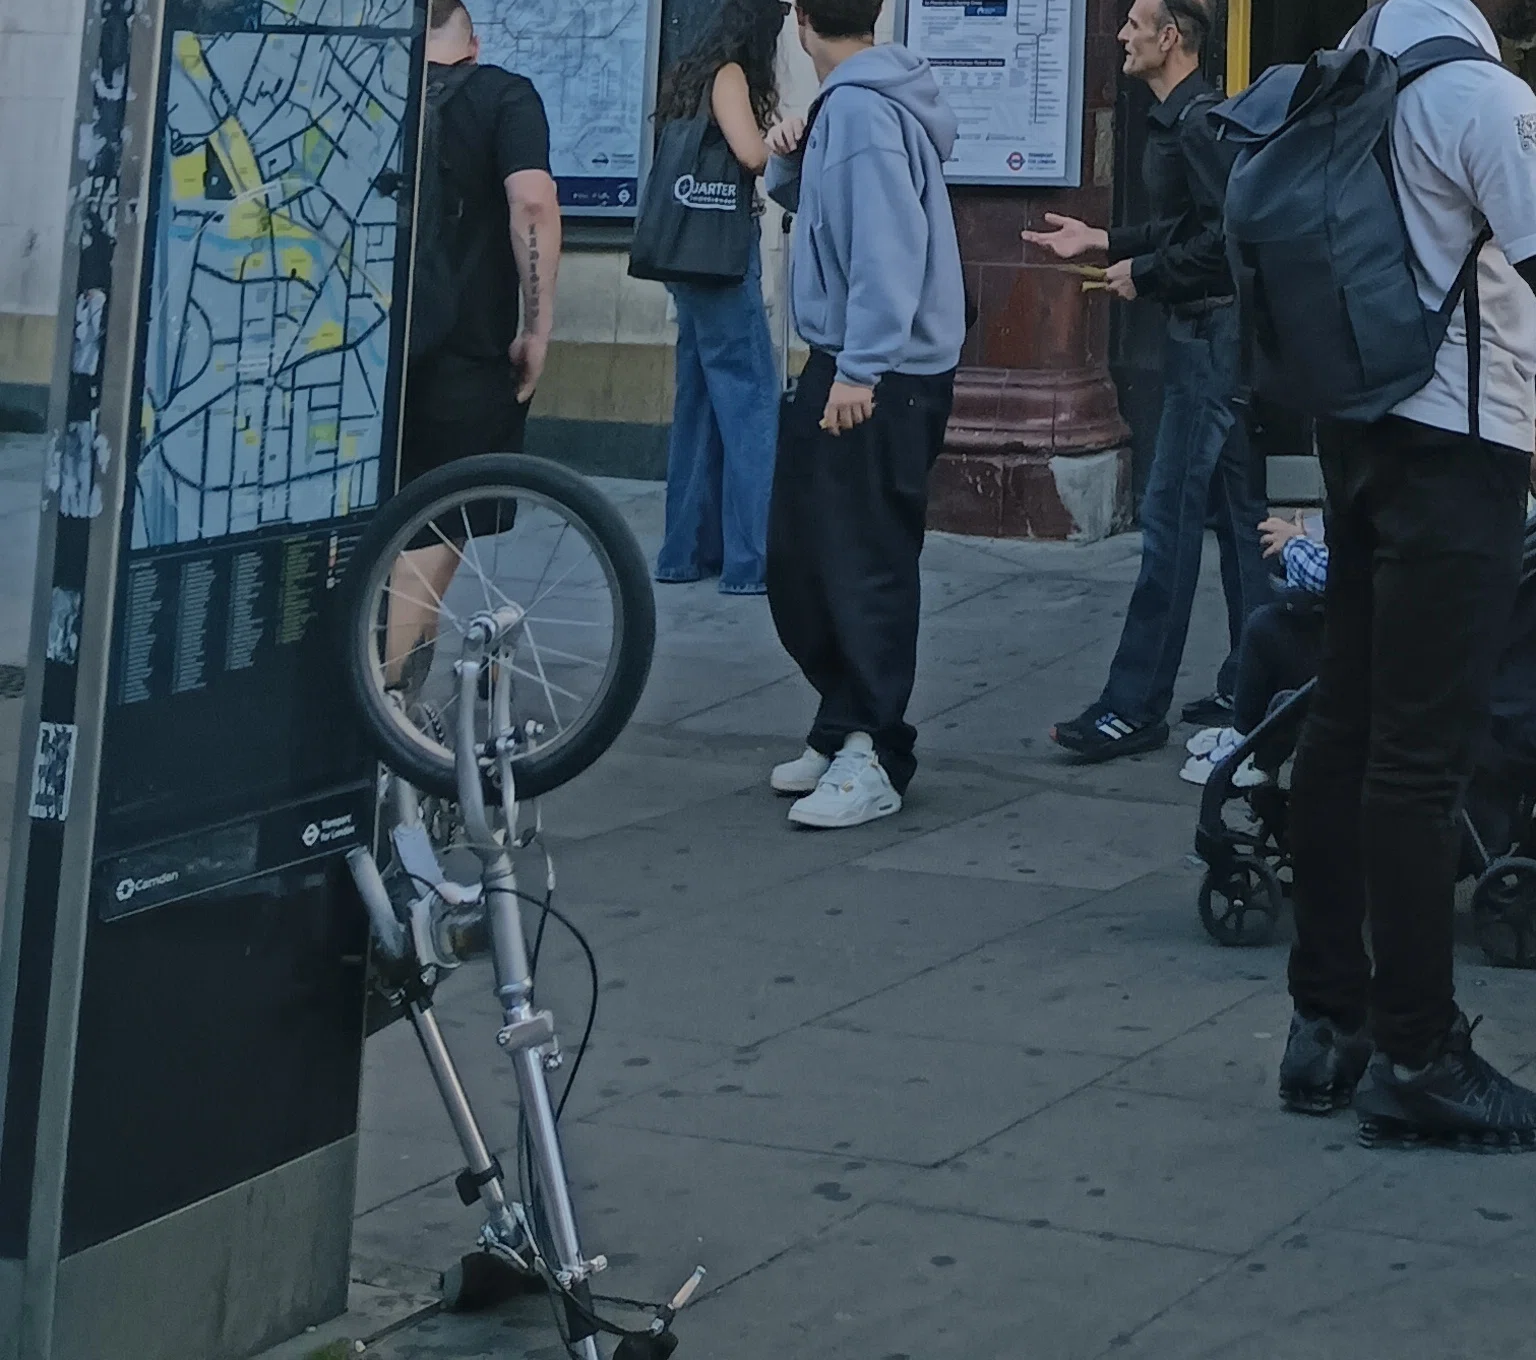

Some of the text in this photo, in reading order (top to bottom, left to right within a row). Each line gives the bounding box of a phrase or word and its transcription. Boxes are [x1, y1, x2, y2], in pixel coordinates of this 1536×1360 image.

[674, 174, 737, 210] QUARTER
[331, 825, 355, 840] London
[135, 871, 179, 892] Camden
